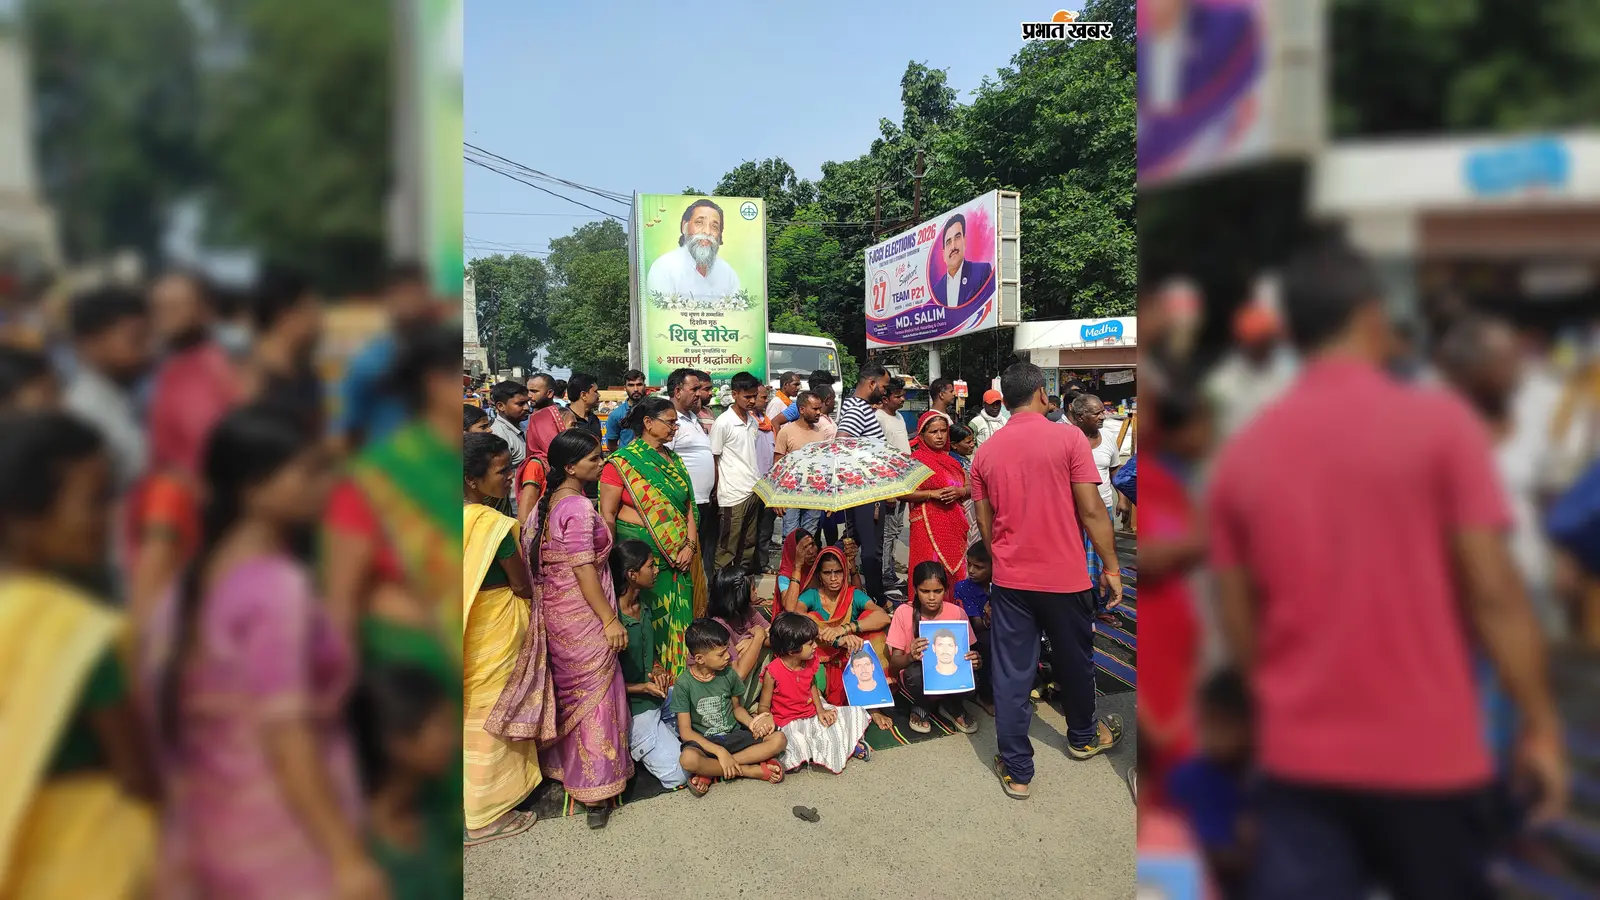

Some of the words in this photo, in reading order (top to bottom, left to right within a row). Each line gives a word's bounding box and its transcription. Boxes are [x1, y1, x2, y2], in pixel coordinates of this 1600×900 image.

[885, 232, 917, 259] ELECTIONS
[916, 223, 937, 246] 2026
[873, 281, 887, 311] 27
[892, 289, 910, 304] TEAM
[911, 285, 925, 301] P21
[895, 315, 913, 329] MD.
[914, 306, 946, 325] SALIM
[669, 324, 701, 346] शिबू
[701, 325, 739, 342] सोरेन
[1085, 324, 1118, 337] Medha
[666, 354, 701, 367] भावपूर्ण
[703, 353, 742, 366] श्रद्धांजलि
